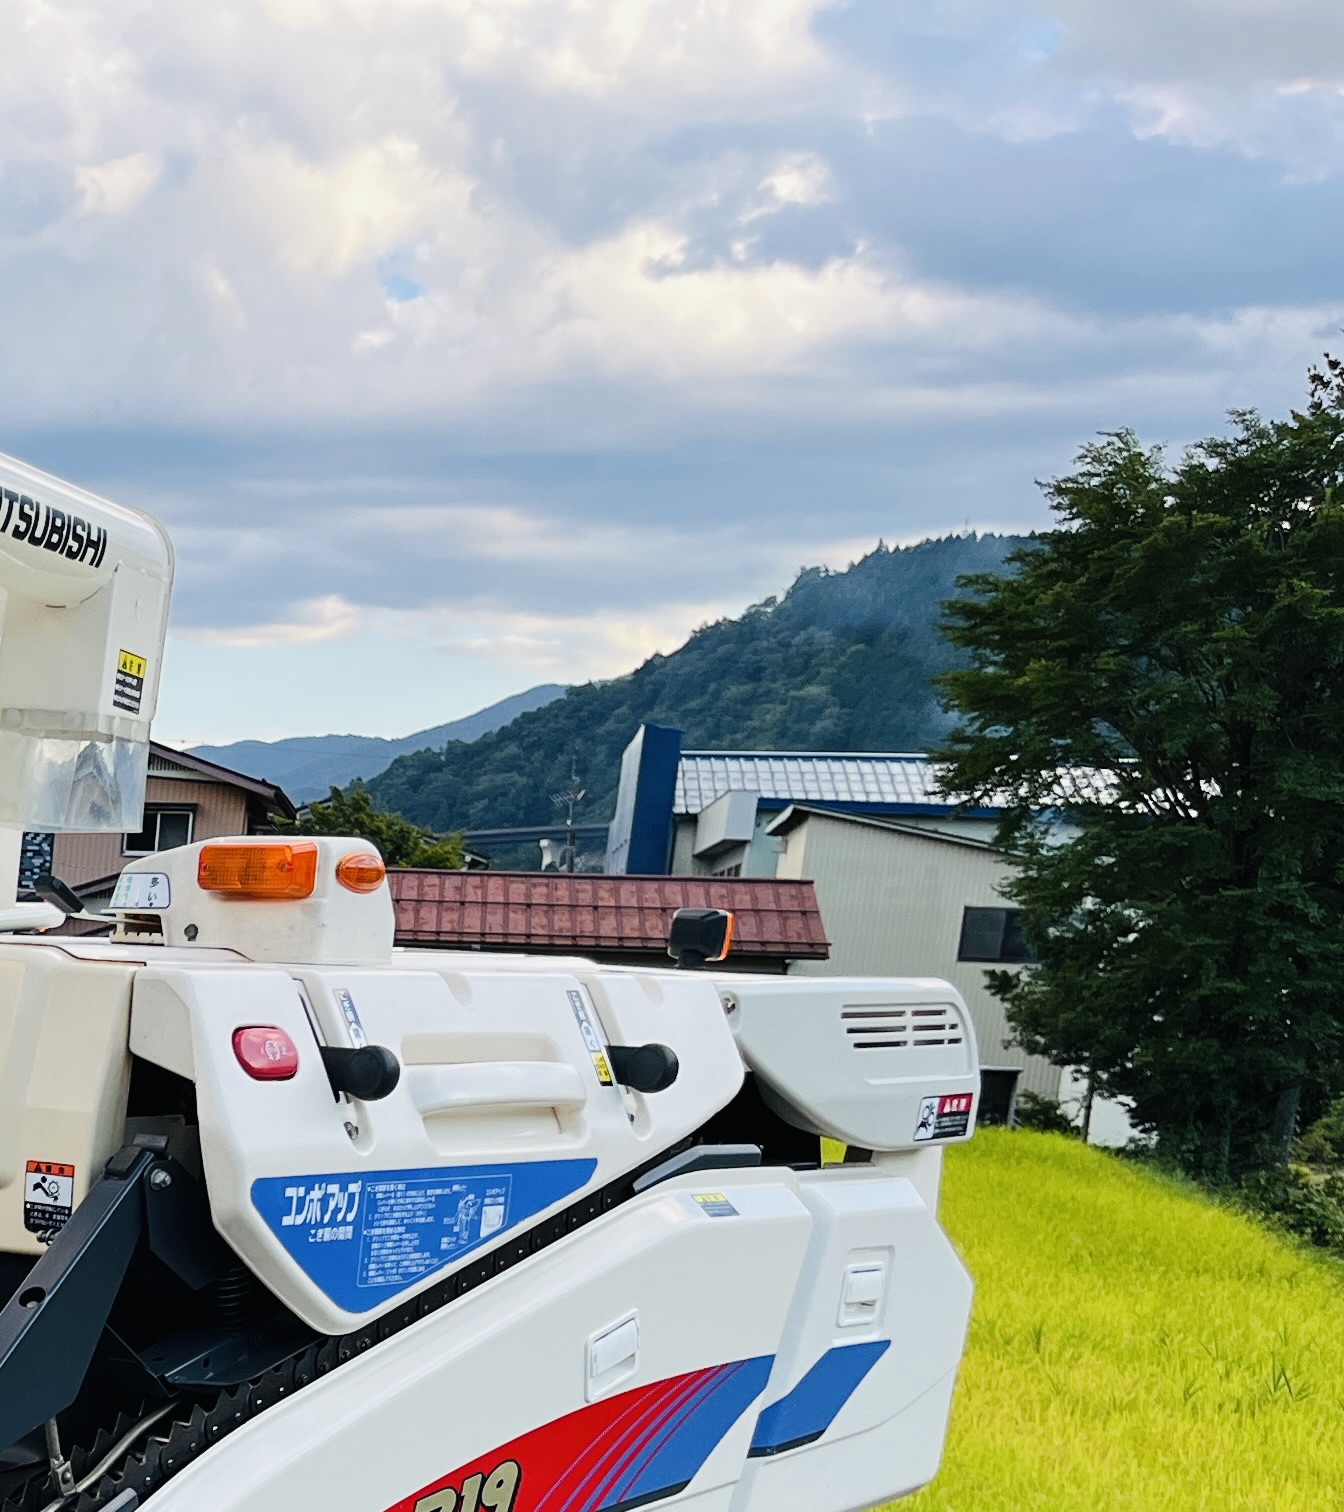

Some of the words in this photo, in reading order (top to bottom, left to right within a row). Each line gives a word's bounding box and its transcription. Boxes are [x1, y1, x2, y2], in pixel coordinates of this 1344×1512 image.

[281, 1180, 362, 1228] コンポアップ
